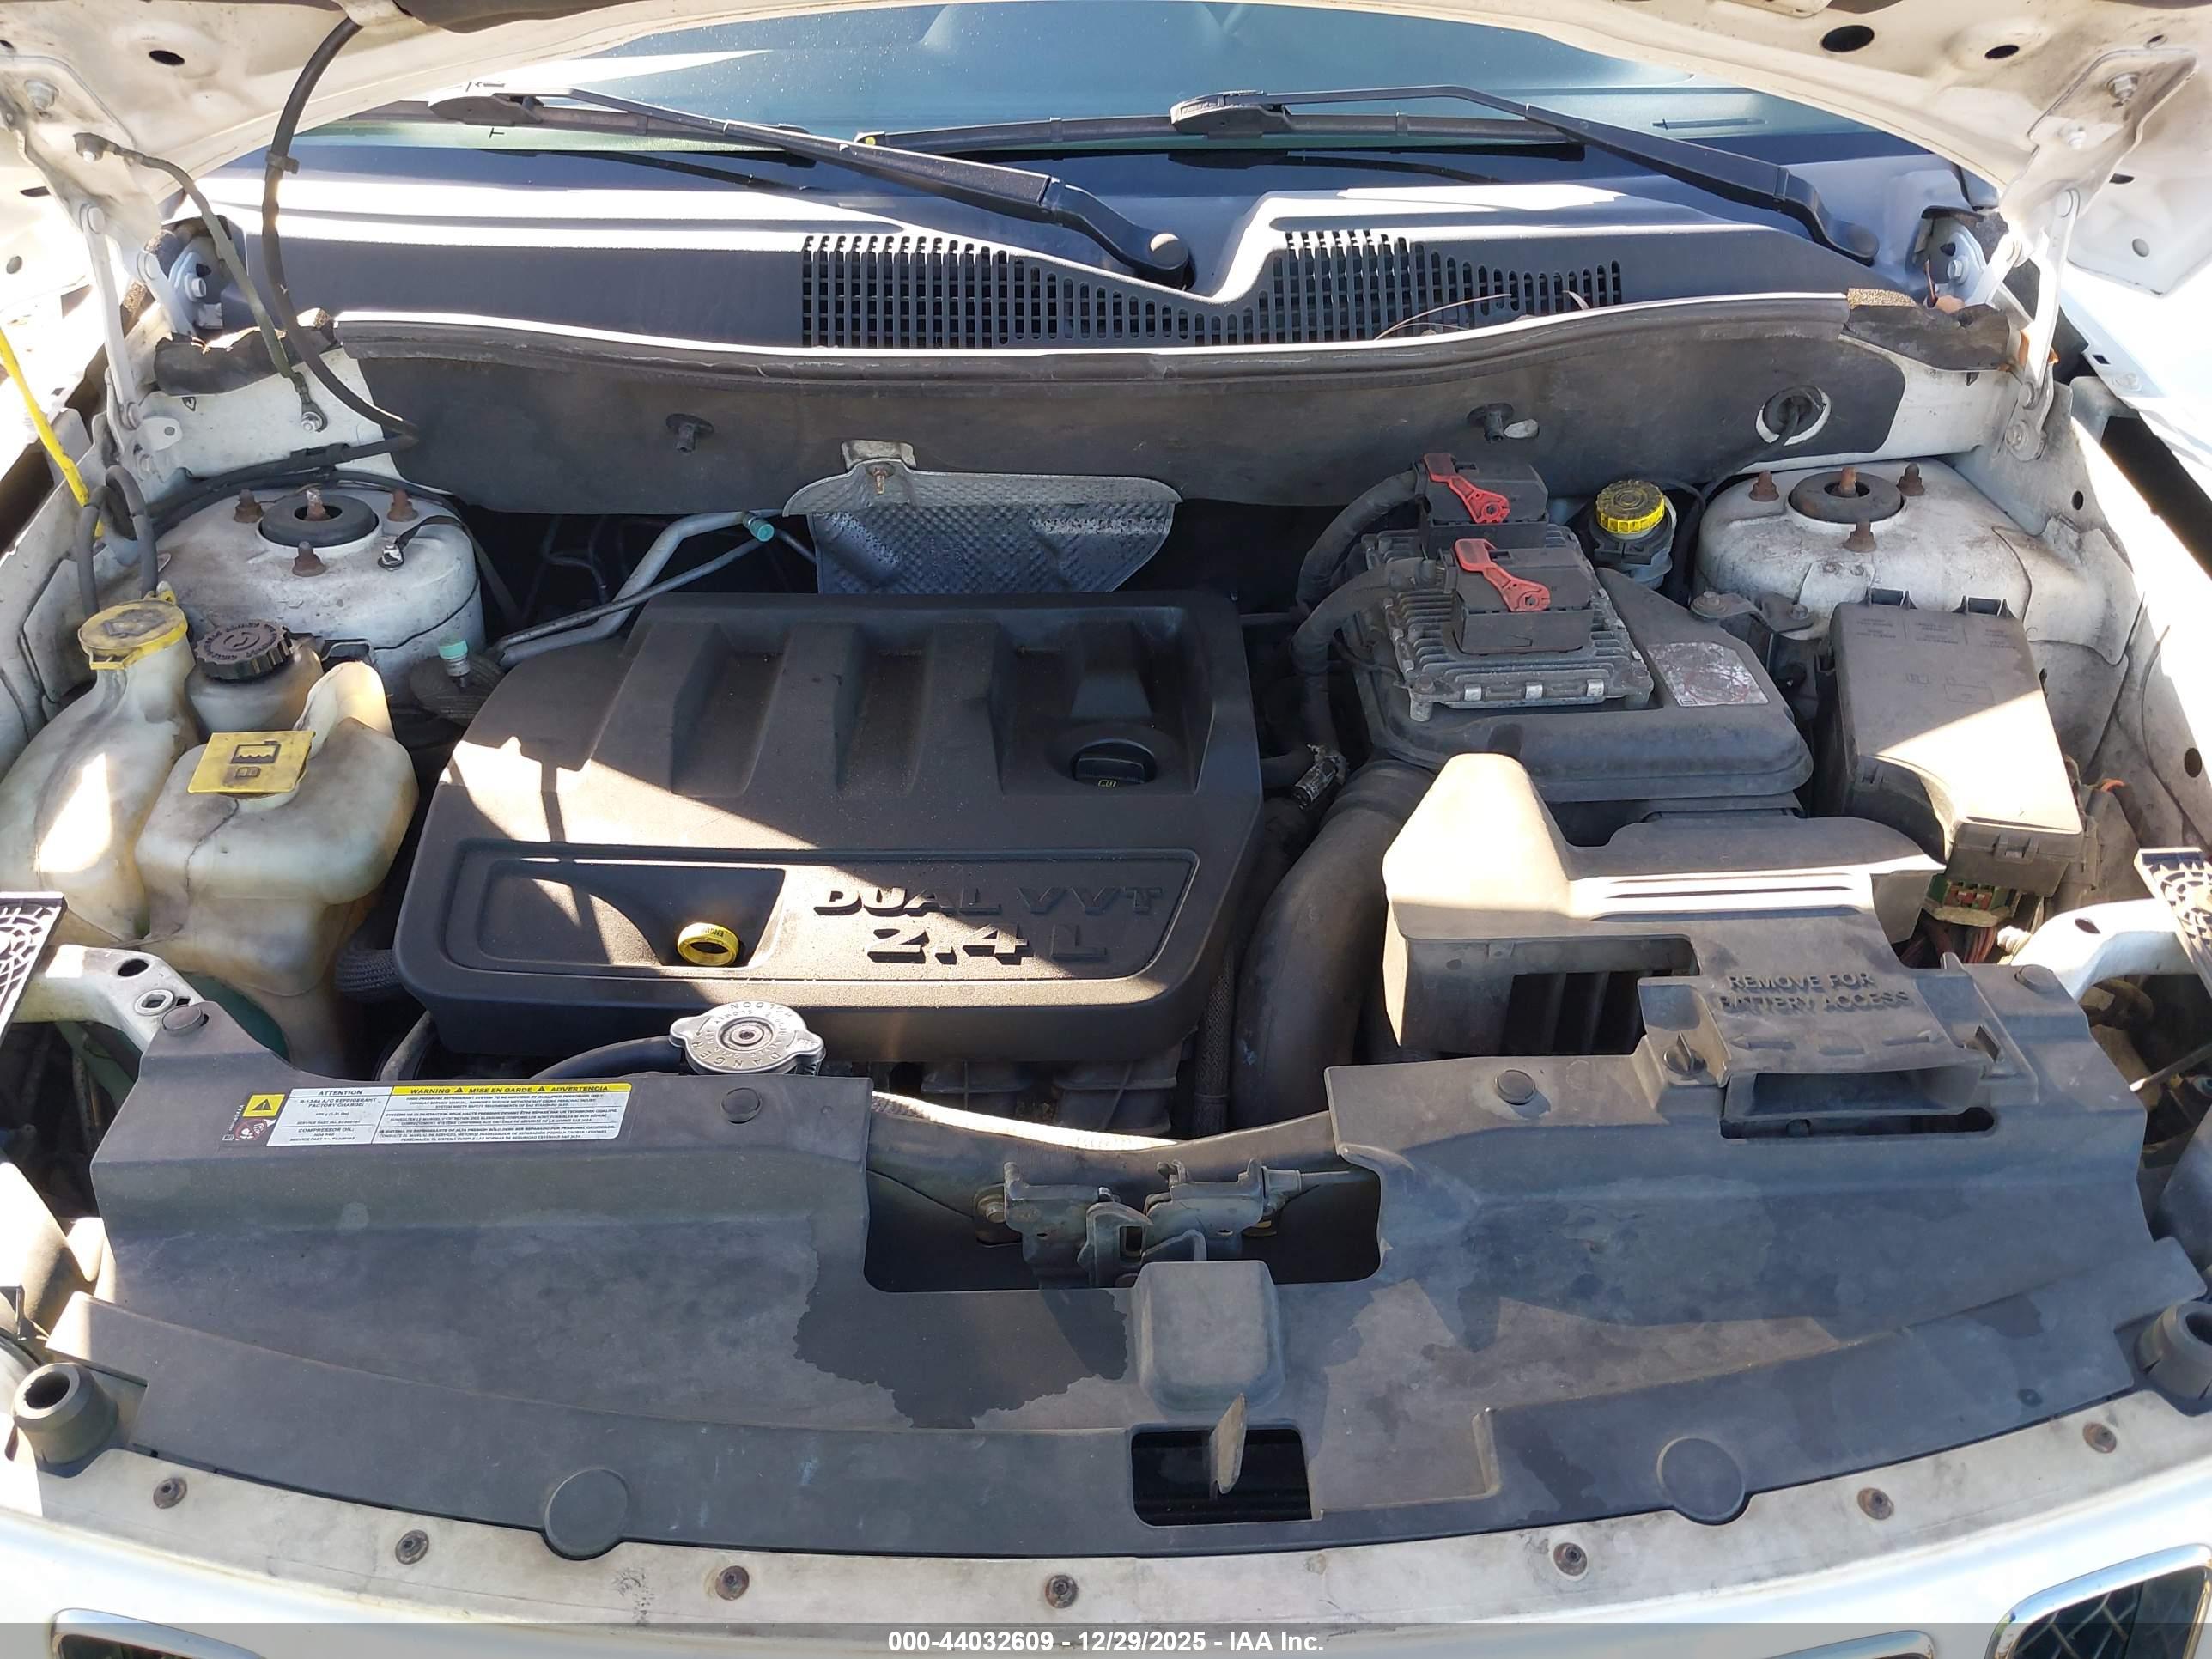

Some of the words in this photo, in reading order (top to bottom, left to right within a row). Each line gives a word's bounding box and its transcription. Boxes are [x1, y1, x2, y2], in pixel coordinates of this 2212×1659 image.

[814, 887, 1001, 916] DUAL
[1018, 885, 1165, 915] VVT
[1726, 974, 1820, 994] REMOVE
[1829, 972, 1875, 990] FOR
[1718, 994, 1815, 1014] BATTERY
[1823, 989, 1915, 1012] ACCESS
[690, 1040, 781, 1070] DANGER
